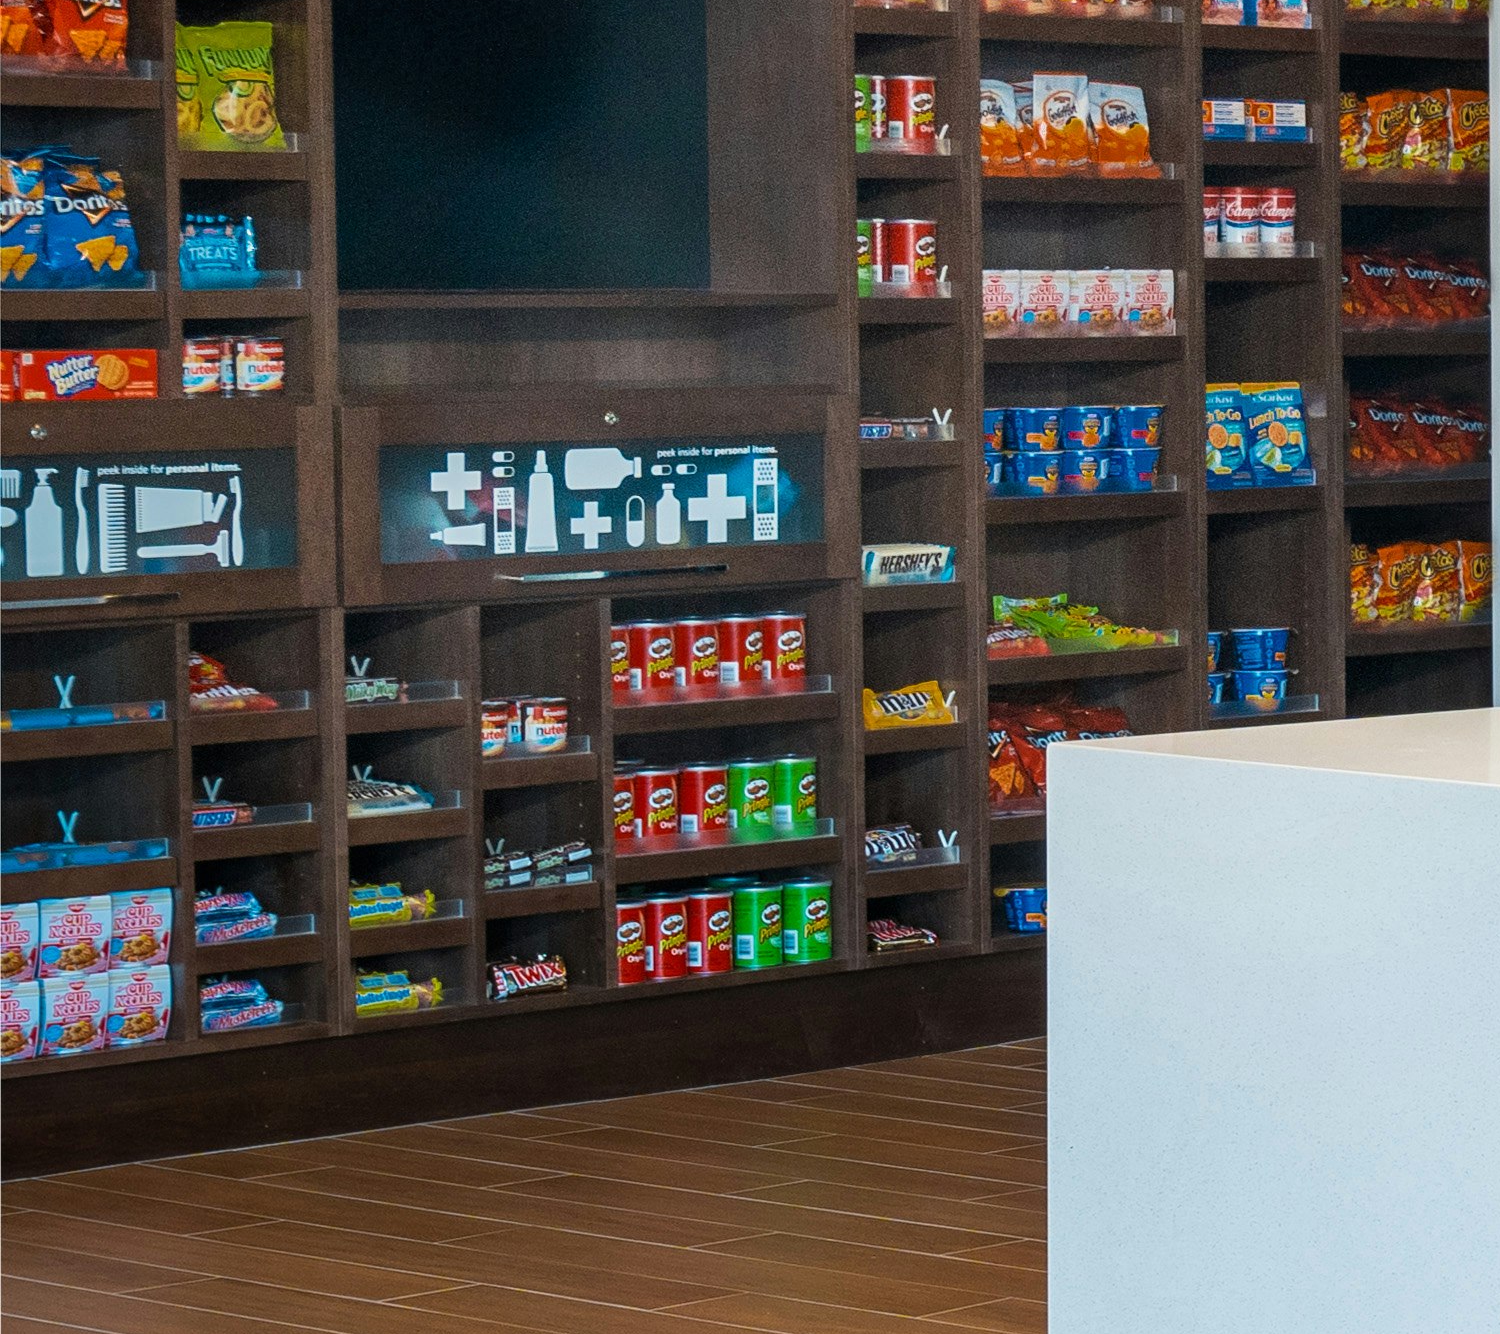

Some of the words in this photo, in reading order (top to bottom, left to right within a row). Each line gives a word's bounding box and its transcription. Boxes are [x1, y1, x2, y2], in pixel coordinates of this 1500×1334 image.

[54, 195, 128, 212] Doritos
[189, 246, 237, 261] TREATS
[47, 355, 93, 382] Nutter
[55, 367, 99, 395] Butter
[657, 448, 676, 459] peek
[678, 447, 700, 456] inside
[702, 447, 713, 455] for
[714, 446, 750, 457] personal
[97, 465, 120, 477] peek
[122, 464, 149, 475] inside
[151, 465, 163, 474] for
[166, 463, 209, 475] personal
[880, 552, 942, 575] HERSHEY'S
[536, 722, 568, 737] nutell
[126, 905, 153, 919] CUP
[62, 914, 91, 927] CUP
[114, 915, 162, 931] NOODLES
[0, 922, 19, 935] UP
[49, 923, 101, 938] NOODLES
[506, 963, 563, 989] TWIX
[126, 983, 152, 996] CUP
[0, 999, 20, 1014] UP
[64, 992, 91, 1006] CUP
[114, 992, 162, 1007] NOODLES
[53, 1001, 101, 1016] NOODLES
